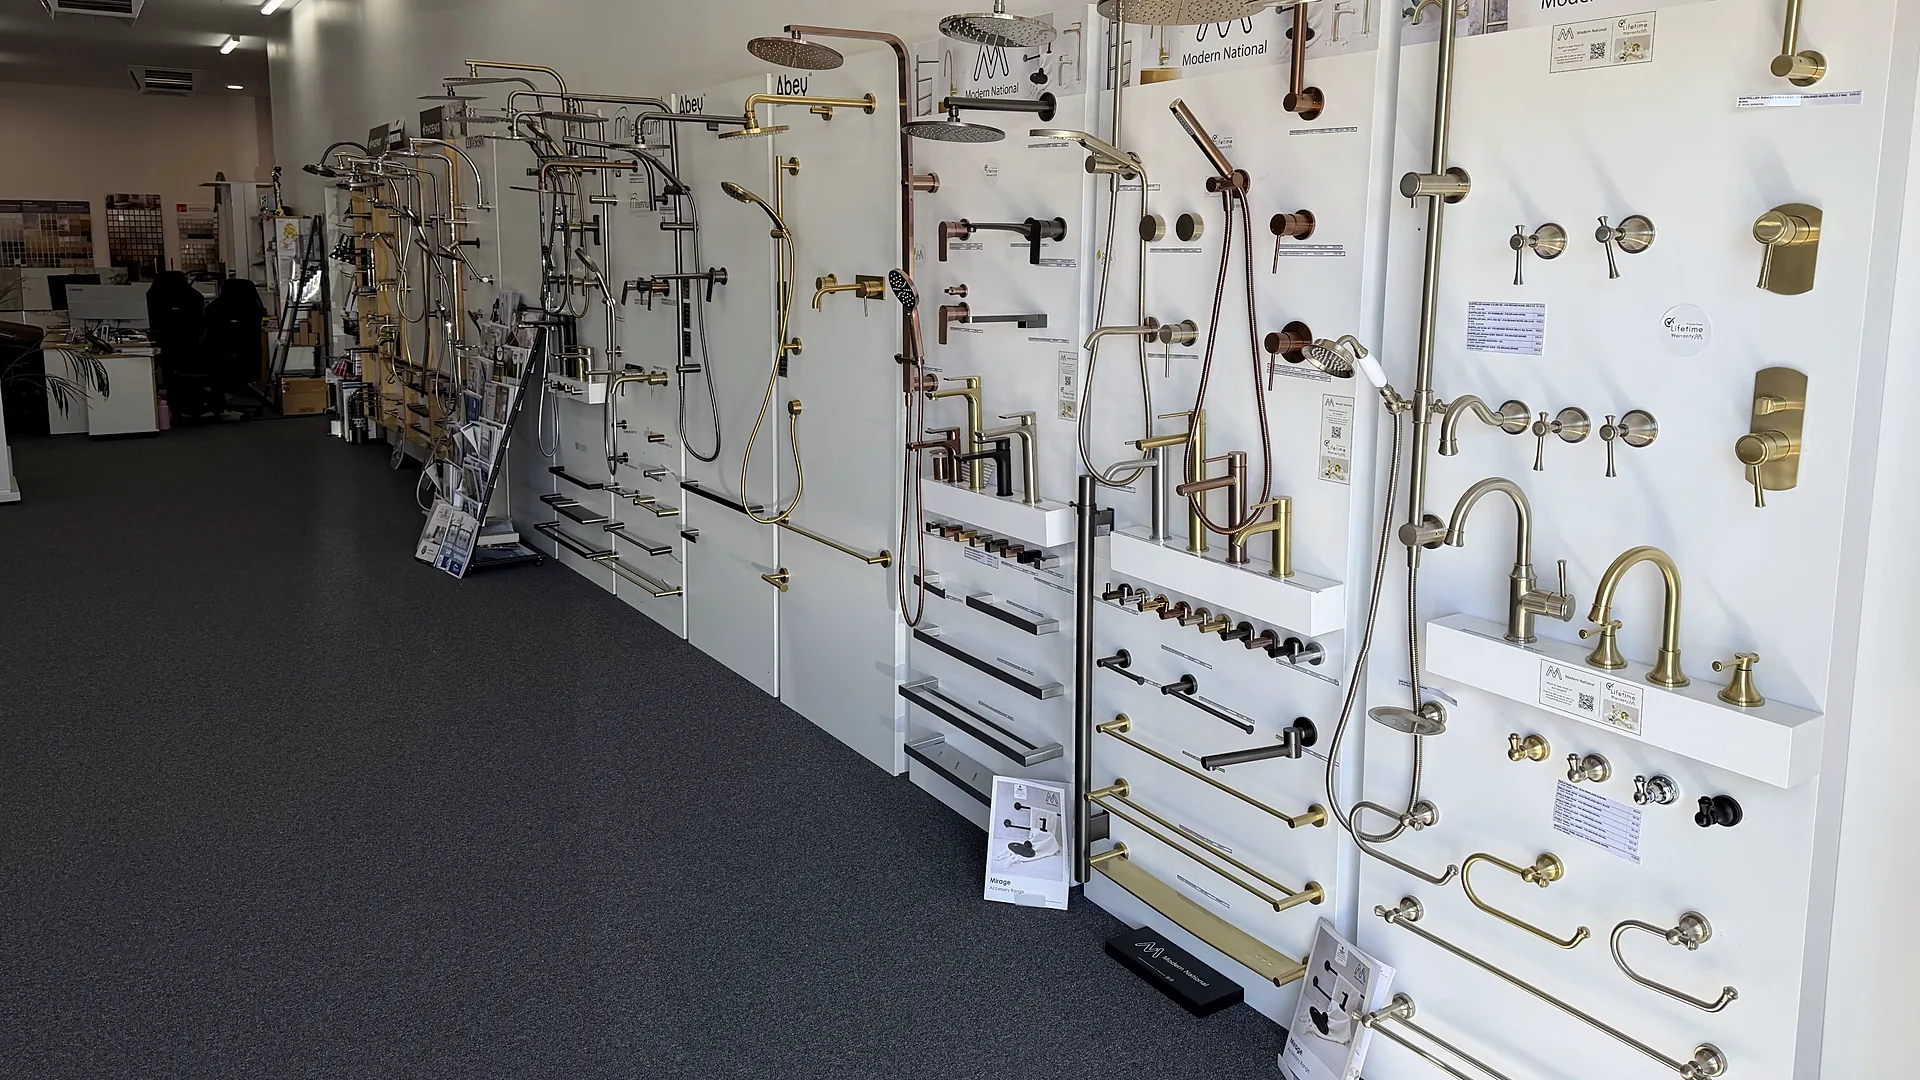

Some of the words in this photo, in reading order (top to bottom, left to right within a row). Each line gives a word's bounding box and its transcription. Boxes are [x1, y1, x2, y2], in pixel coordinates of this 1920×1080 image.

[1182, 50, 1220, 66] Modern
[1223, 39, 1268, 60] National
[776, 74, 808, 96] Abey
[991, 81, 1019, 96] National
[679, 94, 704, 115] Abey
[1670, 324, 1704, 332] Lifetime
[989, 877, 1012, 886] Mirage
[1161, 955, 1184, 971] Modern
[1183, 969, 1210, 988] National
[1289, 1037, 1303, 1056] Mirage
